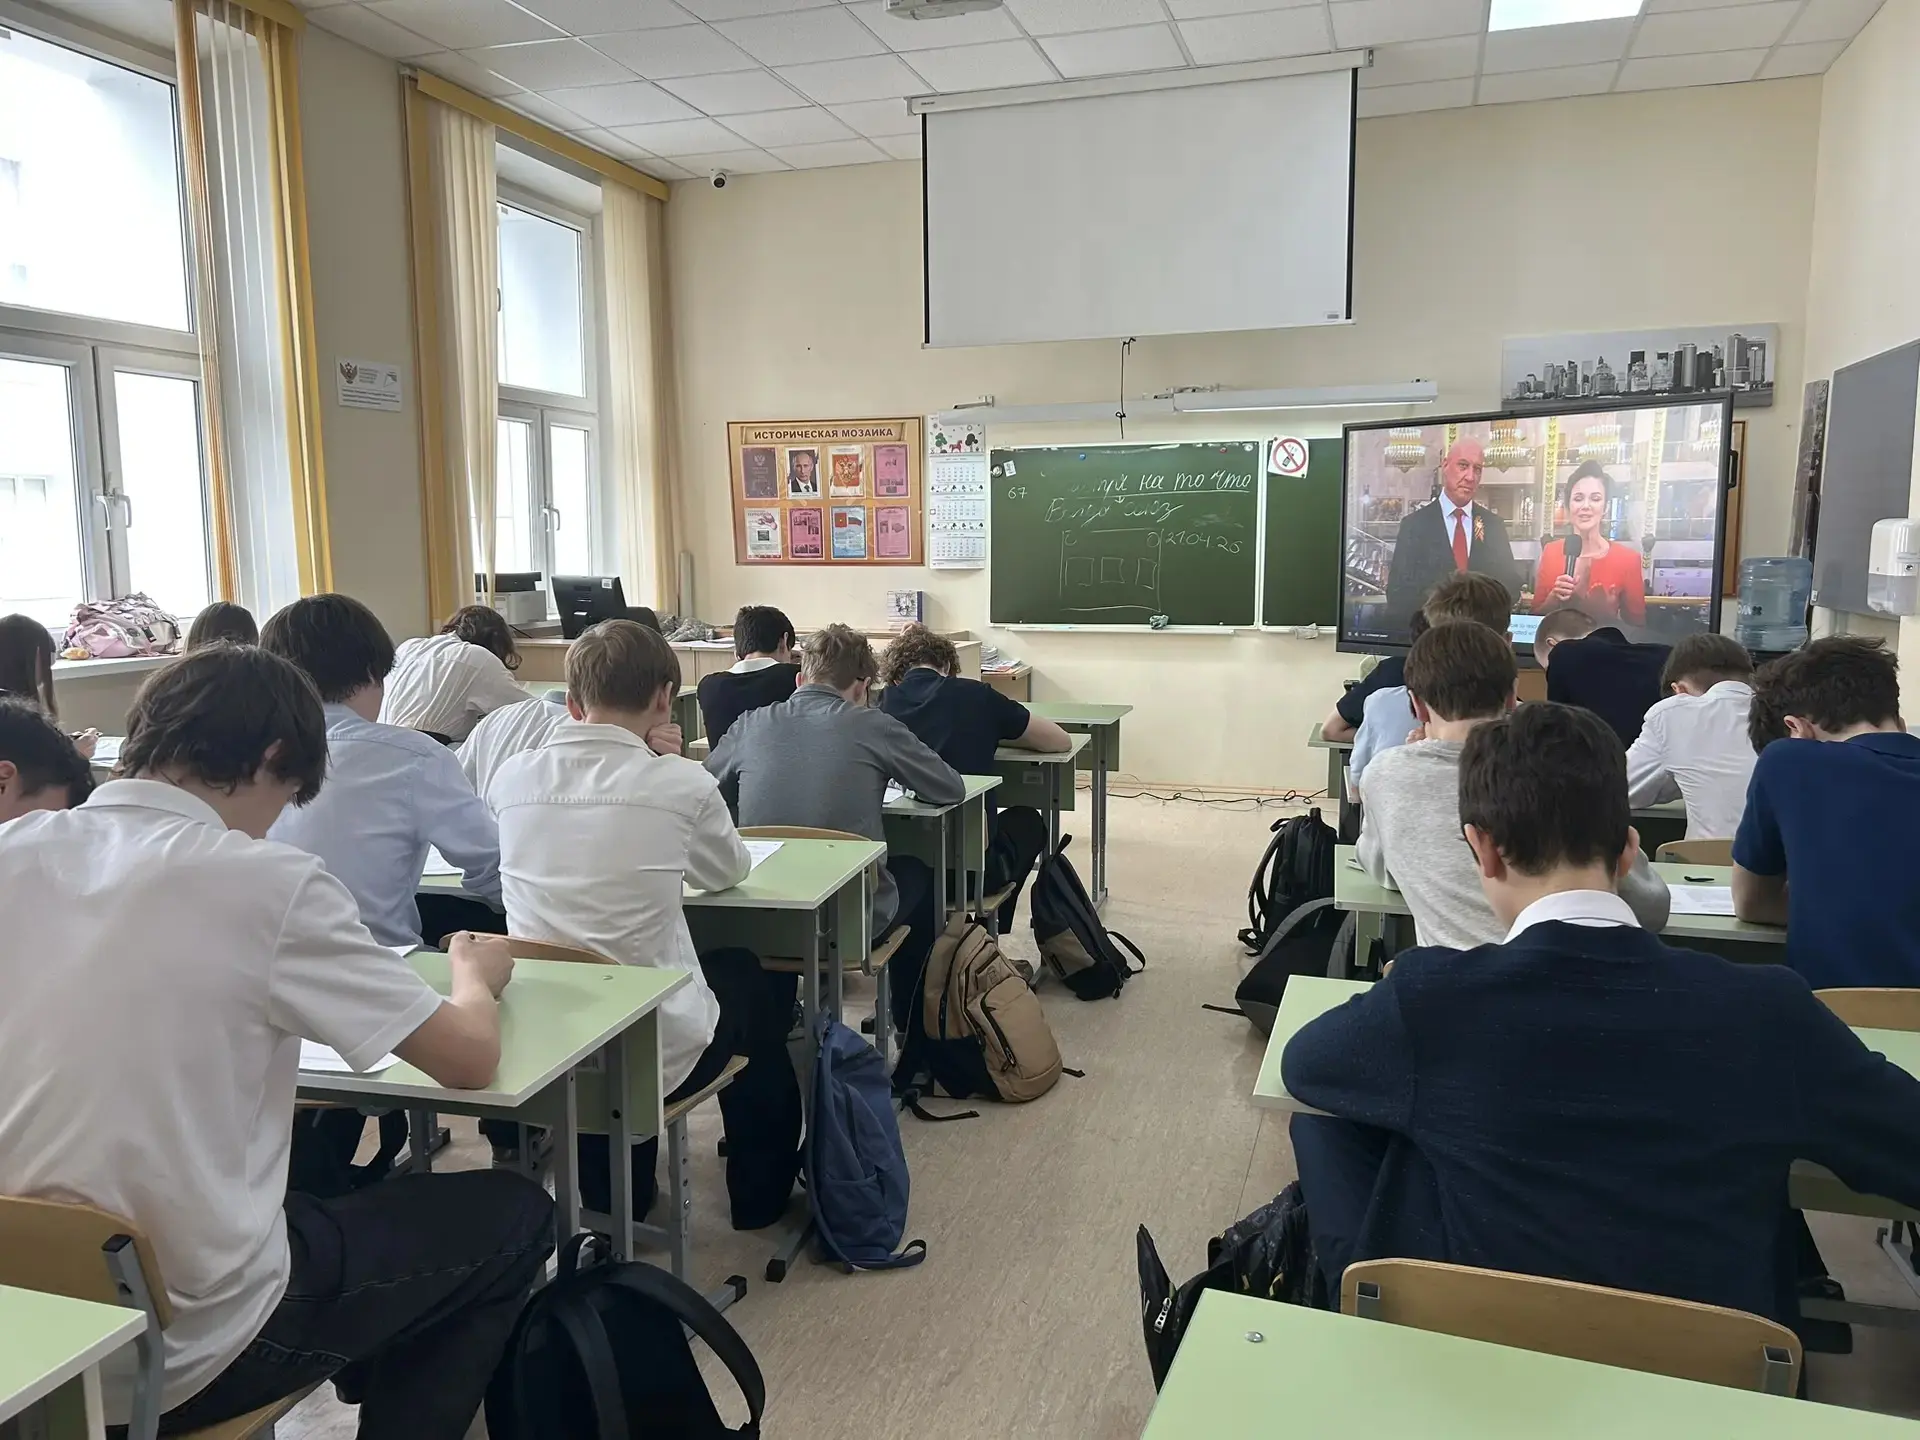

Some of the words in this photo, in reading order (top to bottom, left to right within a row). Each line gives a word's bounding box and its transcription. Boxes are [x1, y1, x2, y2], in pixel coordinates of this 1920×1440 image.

[754, 430, 838, 440] ИСТОРИЧЕСКАЯ
[841, 428, 893, 438] МОЗАИКА
[1139, 473, 1165, 491] на
[1174, 472, 1205, 491] то
[1210, 469, 1252, 490] что
[1007, 486, 1028, 499] 67
